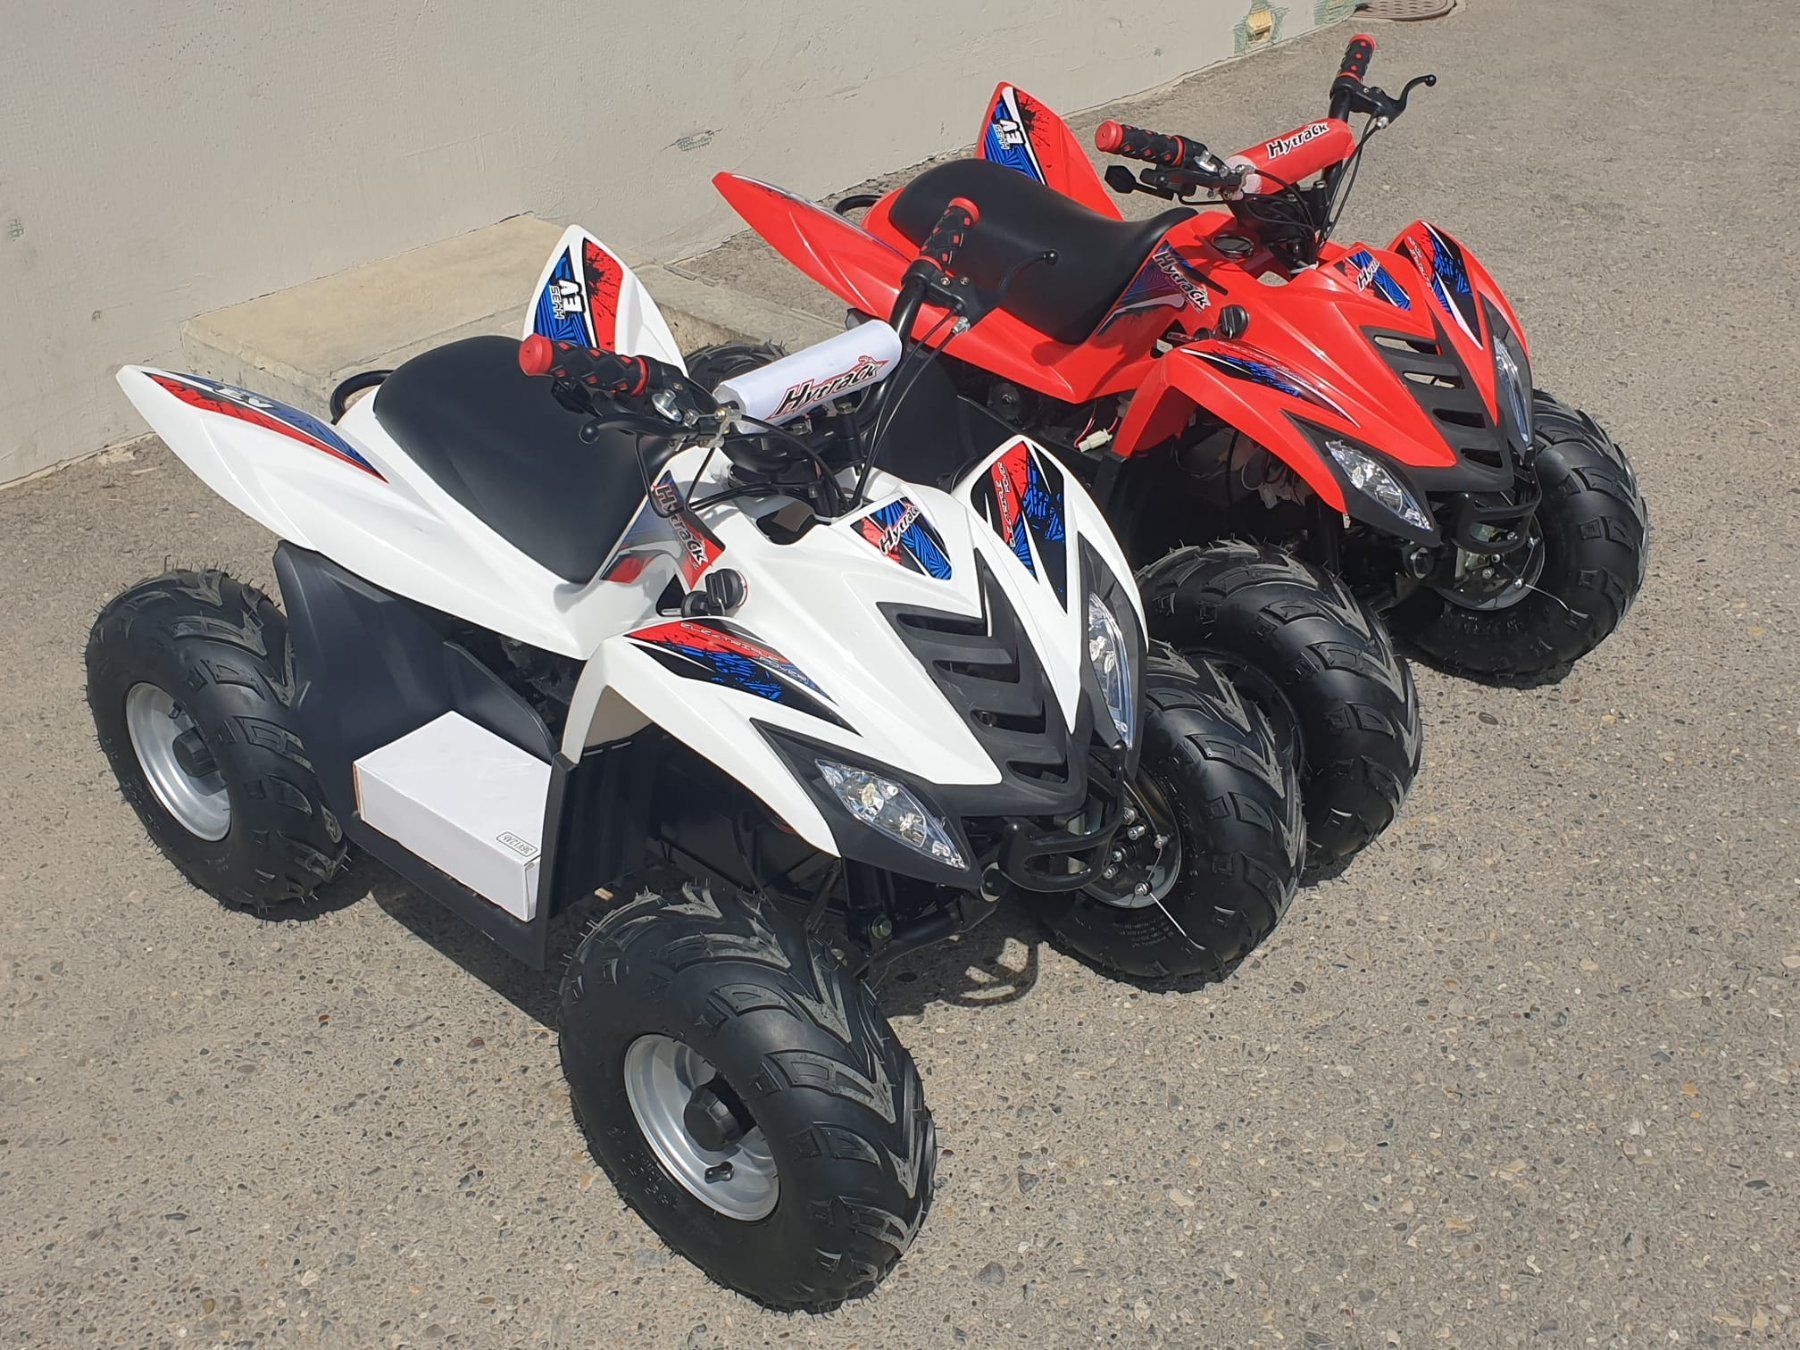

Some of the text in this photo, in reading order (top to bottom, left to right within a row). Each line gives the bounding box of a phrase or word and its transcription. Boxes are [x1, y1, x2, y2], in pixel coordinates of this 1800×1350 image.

[1266, 122, 1331, 159] Hytrack
[558, 279, 584, 312] EV
[1152, 250, 1211, 311] Hytrack
[771, 360, 884, 417] Hytrack
